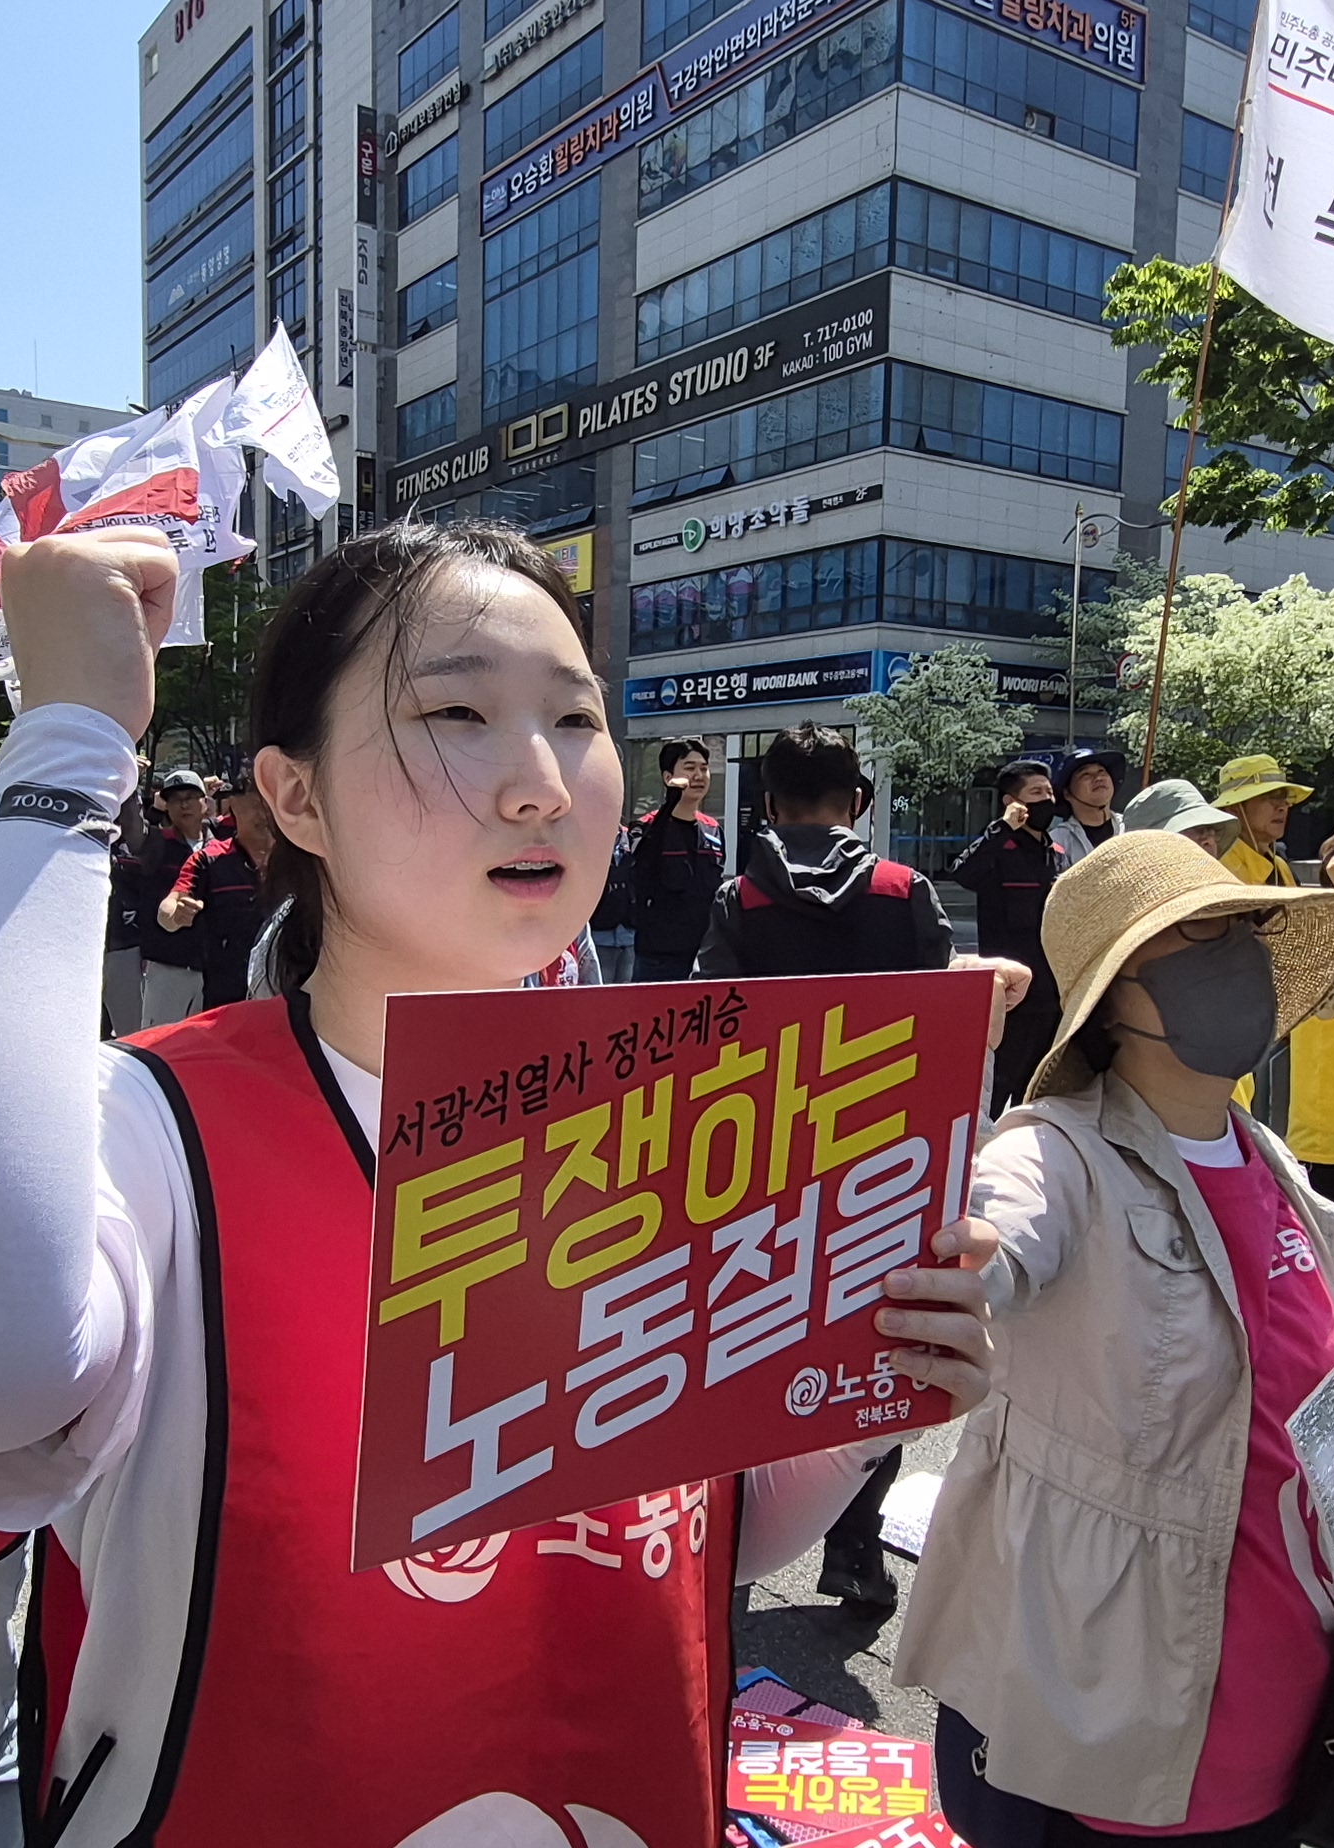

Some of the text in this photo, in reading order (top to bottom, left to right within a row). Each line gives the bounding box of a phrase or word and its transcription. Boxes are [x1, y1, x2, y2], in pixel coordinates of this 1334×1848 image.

[669, 0, 833, 100] 구강악안면외과전문
[975, 0, 1136, 71] 힐링치과의원
[817, 309, 874, 344] 717-0100
[846, 330, 874, 356] GYM
[396, 462, 450, 503] FITNESS
[451, 446, 490, 484] CLUB
[577, 381, 660, 439] PILATES
[667, 347, 749, 407] STUDIO
[753, 341, 776, 371] 3F
[710, 495, 811, 540] 희망조약돌
[680, 672, 749, 704] 우리은행
[753, 670, 820, 691] WOORI BANK
[1002, 675, 1039, 692] WOORI
[11, 793, 69, 813] COOL
[385, 985, 749, 1158] 서광석열사 정신계승
[378, 1002, 918, 1349] 투쟁하는
[410, 1112, 971, 1543] 노동절을!
[855, 1398, 912, 1429] 전북도당
[745, 1774, 929, 1817] 투쟁하는
